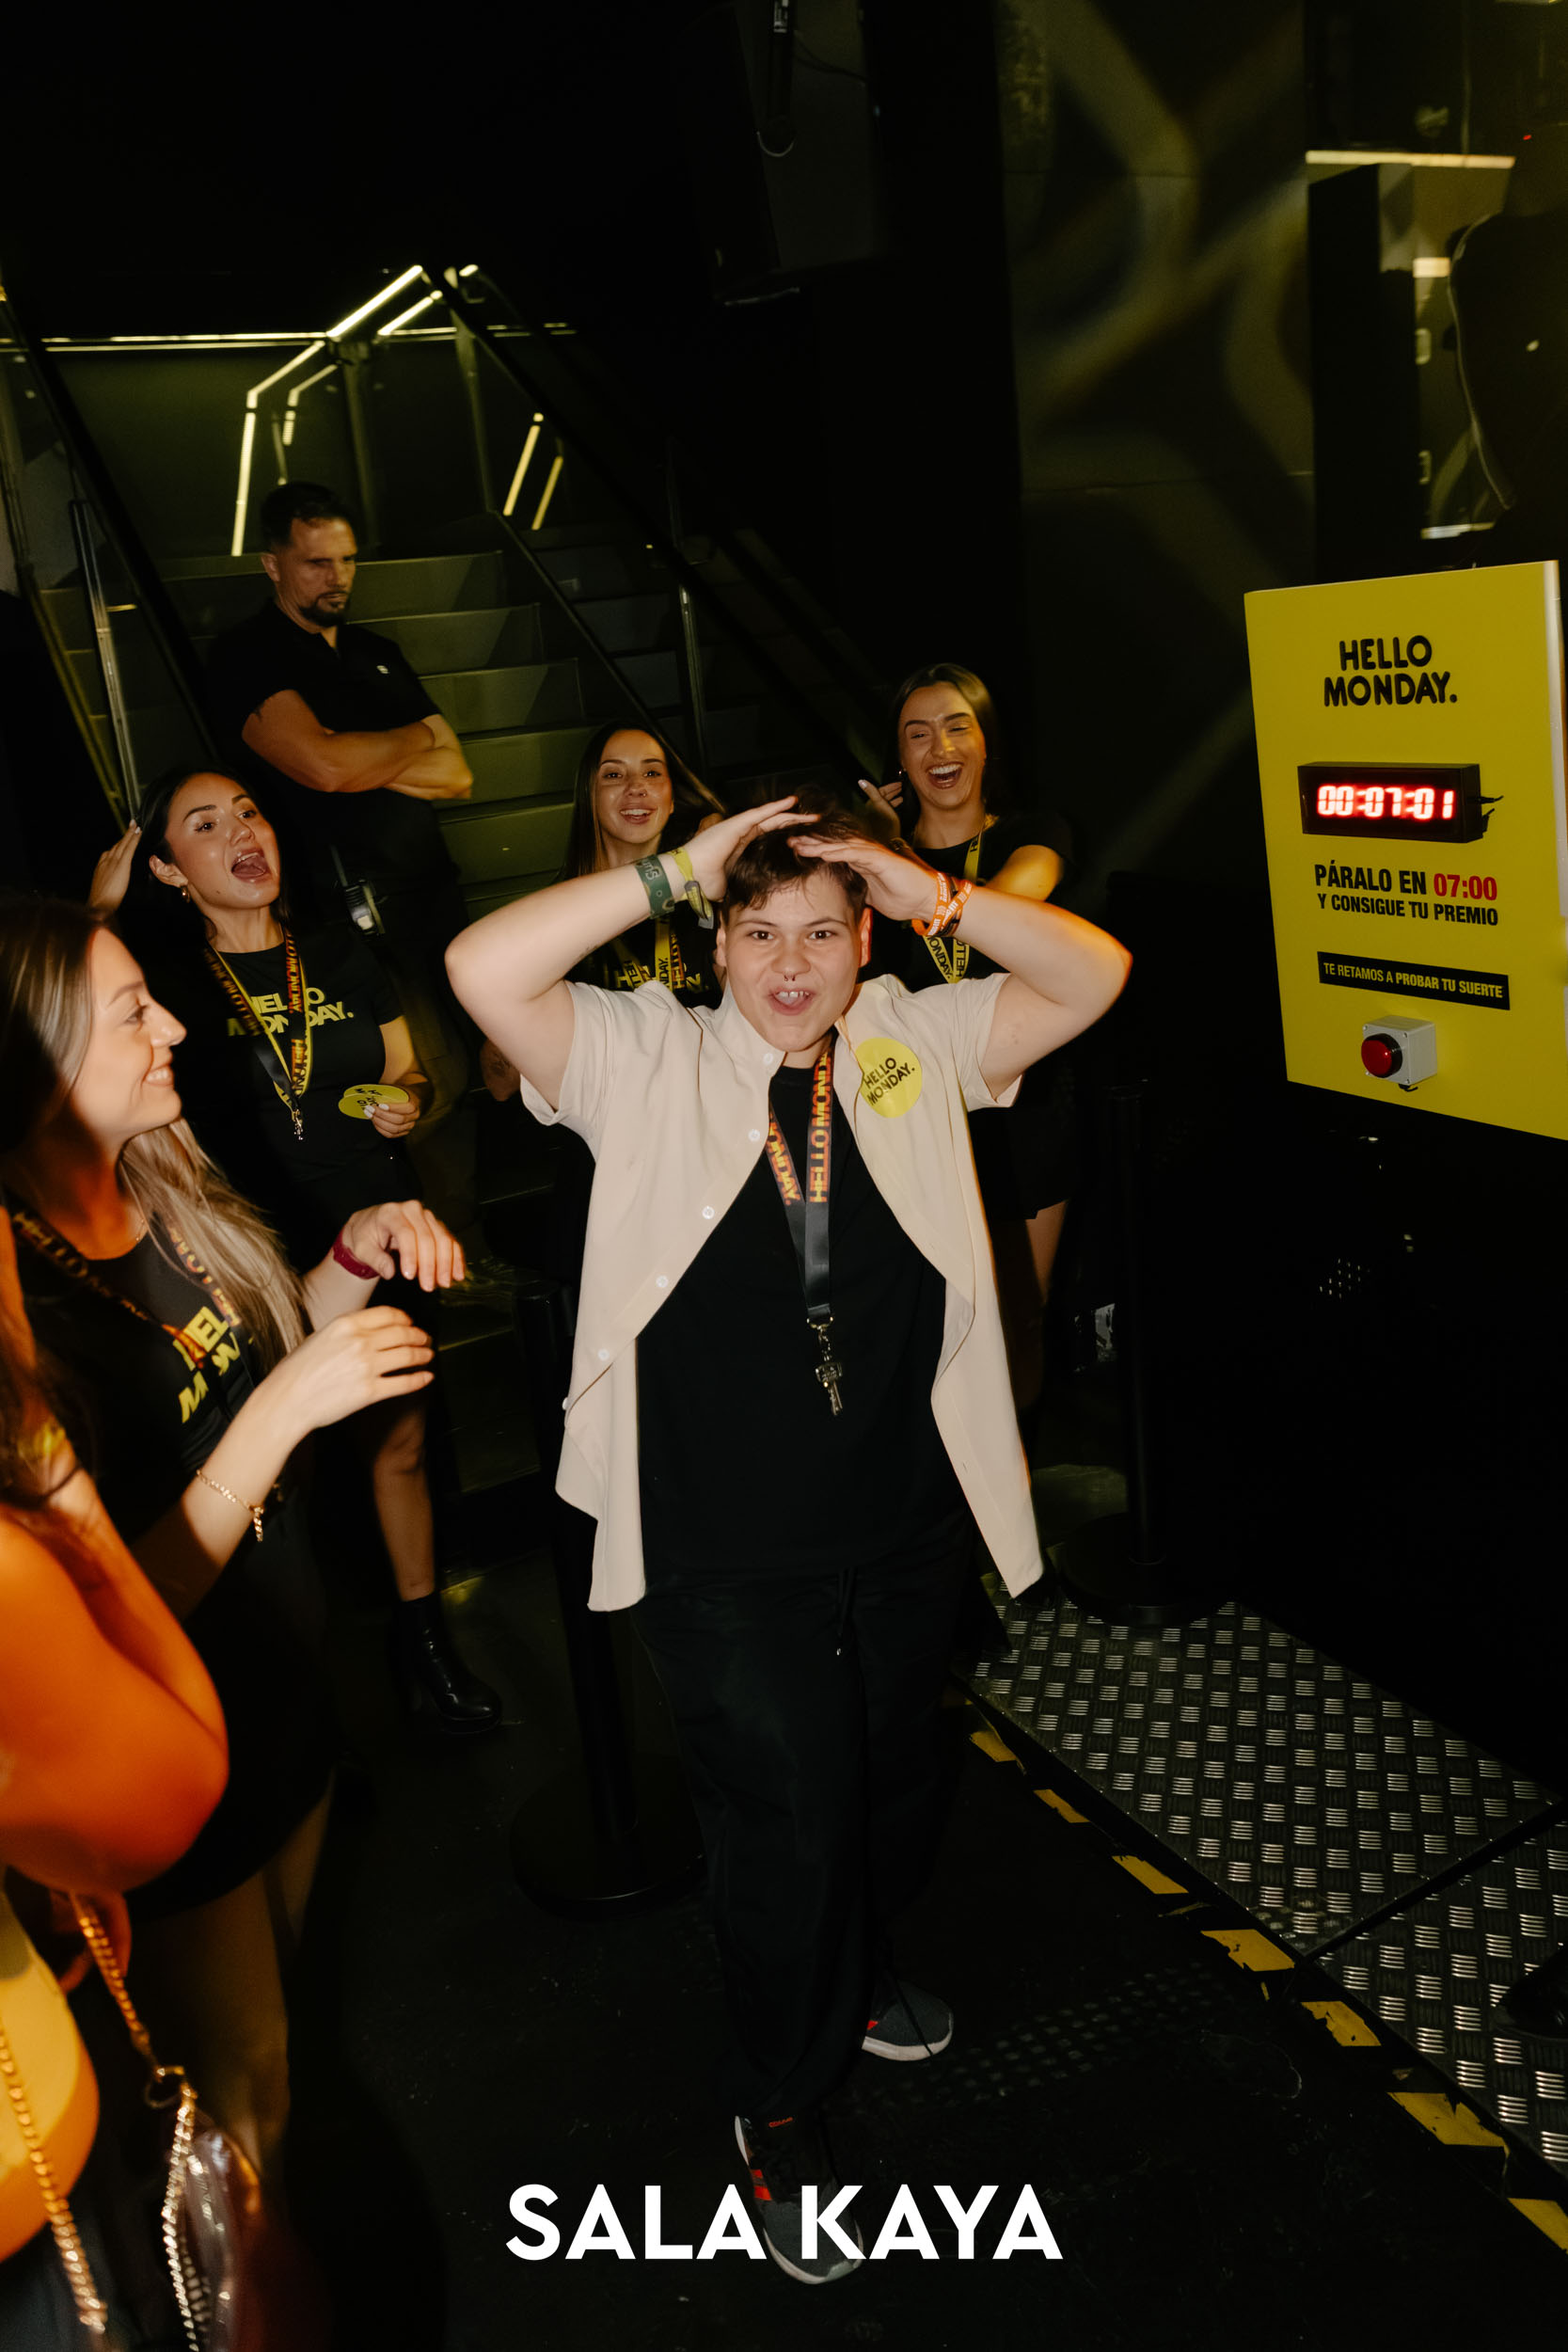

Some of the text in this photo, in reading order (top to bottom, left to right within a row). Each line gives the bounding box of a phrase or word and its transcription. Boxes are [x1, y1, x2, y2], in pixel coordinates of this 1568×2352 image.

[1338, 635, 1433, 672] HELLO
[1323, 672, 1458, 707] MONDAY.
[1317, 785, 1456, 820] 00:07:01
[1314, 860, 1497, 901] PÁRALO EN 07:00
[1317, 893, 1498, 926] Y CONSIGUE TU PREMIO
[1323, 962, 1504, 998] TE RETAMOS A PROBAR TU SUERTE
[864, 1057, 896, 1089] HELLO
[866, 1062, 915, 1105] MONDAY.
[809, 1130, 830, 1202] HELLO
